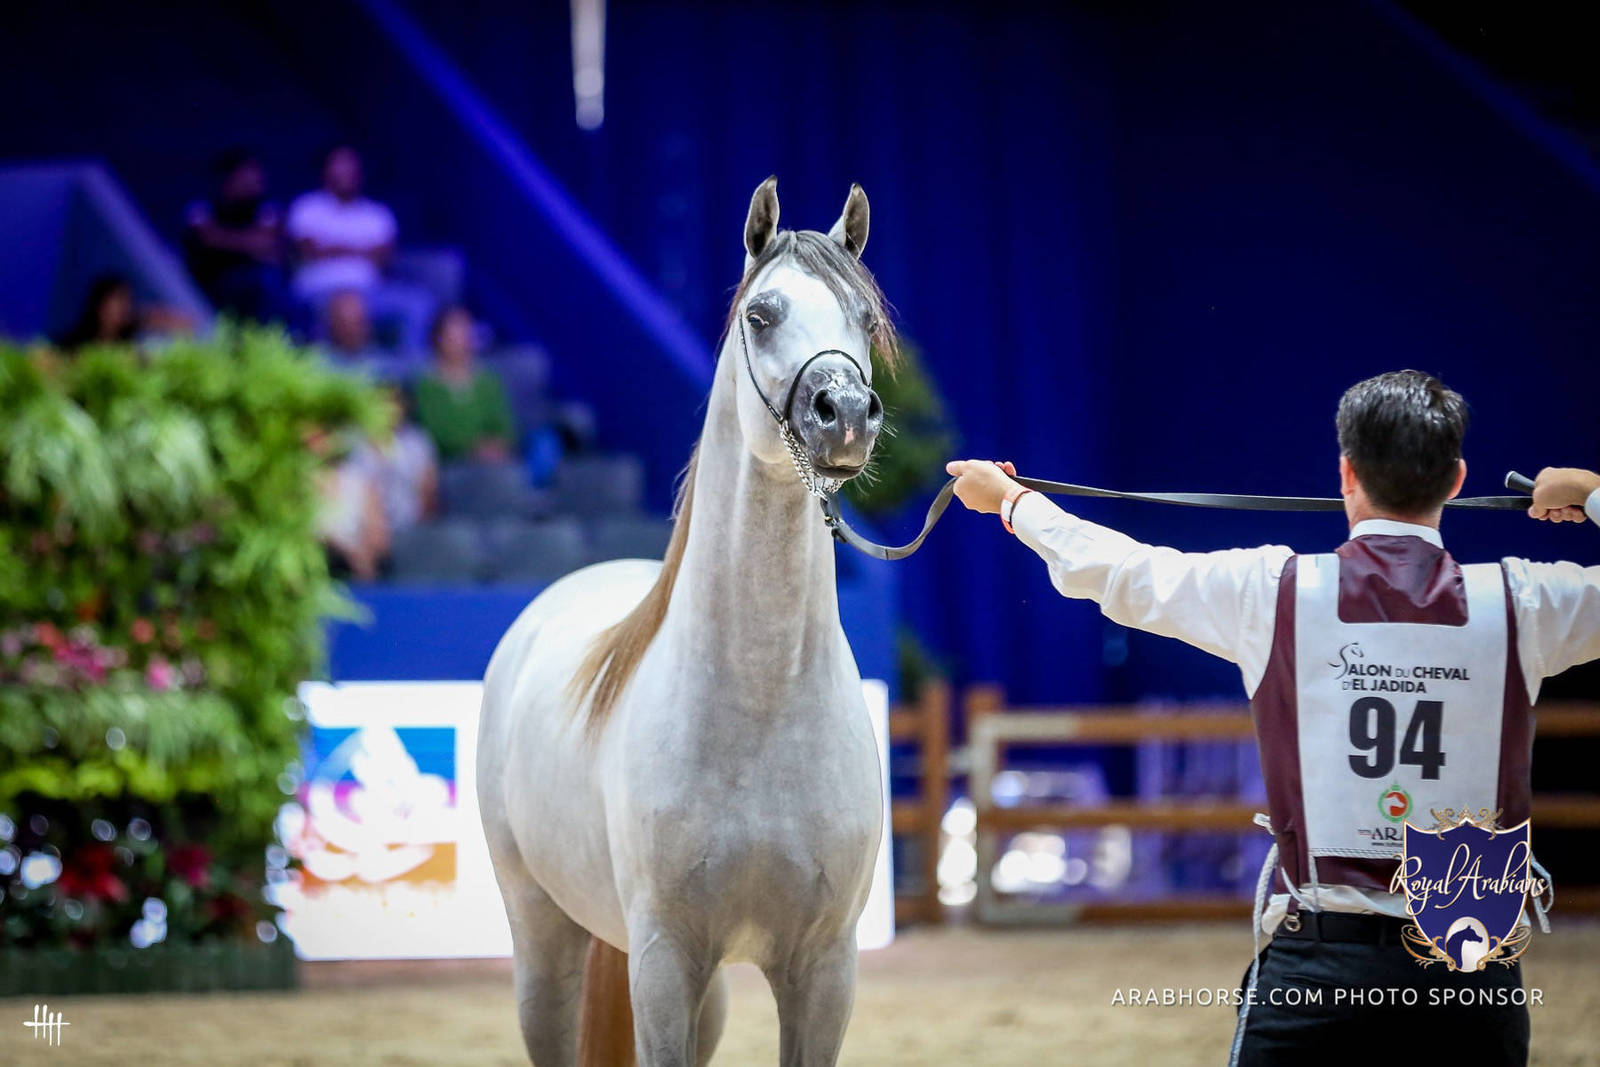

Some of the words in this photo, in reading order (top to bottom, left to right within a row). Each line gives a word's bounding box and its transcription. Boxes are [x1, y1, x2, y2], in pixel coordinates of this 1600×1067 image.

[1395, 667, 1411, 678] DU
[1413, 666, 1470, 681] CHEVAL
[1371, 680, 1427, 694] JADIDA
[1348, 696, 1446, 781] 94
[1371, 827, 1403, 841] AR
